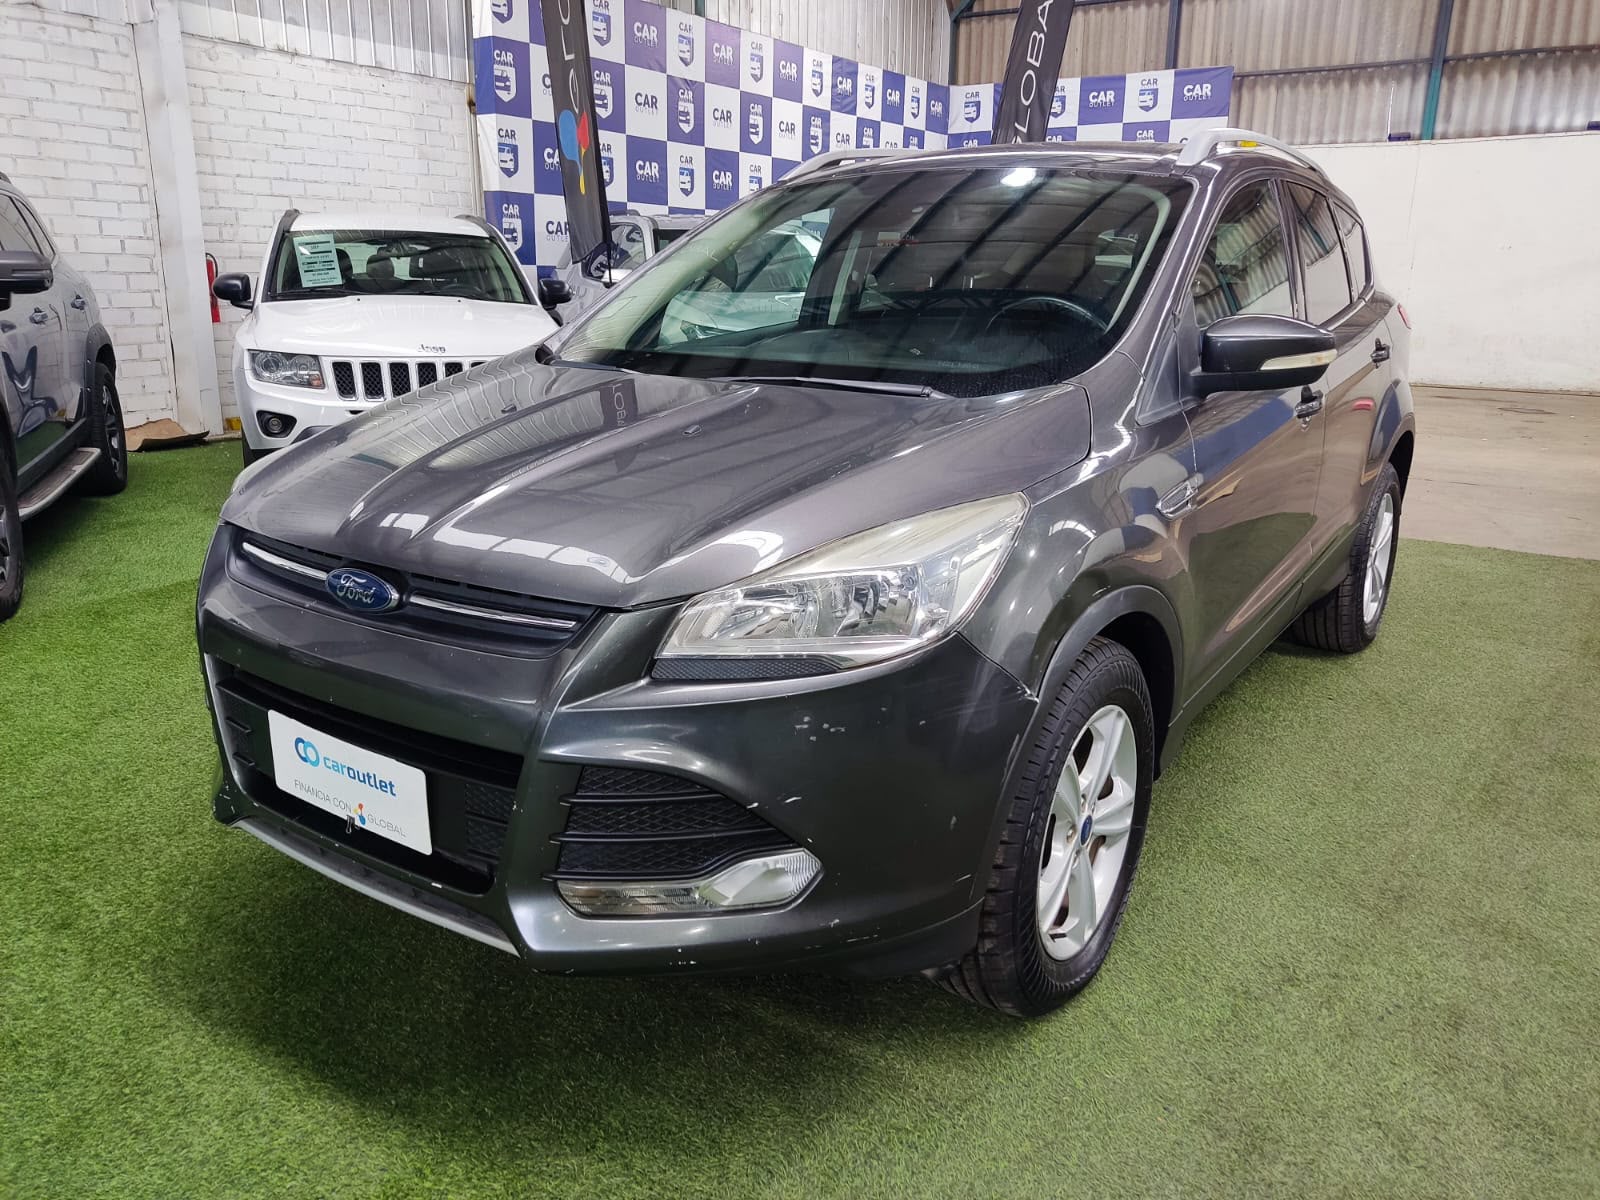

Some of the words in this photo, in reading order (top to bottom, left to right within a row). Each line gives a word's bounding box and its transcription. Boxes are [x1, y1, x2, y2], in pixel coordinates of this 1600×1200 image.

[633, 22, 658, 41] CAR
[713, 42, 733, 61] CAR
[750, 41, 763, 52] CAR
[493, 49, 514, 65] CAR
[812, 59, 823, 68] CAR
[779, 60, 797, 77] CAR
[593, 70, 611, 84] CAR
[837, 76, 853, 91] CAR
[1140, 78, 1158, 86] CAR
[678, 88, 693, 99] CAR
[886, 88, 900, 102] CAR
[1088, 90, 1115, 102] CAR
[1183, 83, 1212, 96] CAR
[634, 92, 658, 109] CAR
[930, 100, 943, 114] CAR
[712, 108, 732, 123] CAR
[749, 103, 762, 114] CAR
[778, 120, 796, 134] CAR
[810, 116, 822, 126] CAR
[497, 128, 516, 140] CAR
[835, 132, 851, 145] CAR
[863, 127, 873, 137] CAR
[1136, 129, 1154, 139] CAR
[679, 155, 693, 165] CAR
[635, 160, 659, 178] CAR
[749, 164, 762, 173] CAR
[712, 170, 732, 186] CAR
[502, 203, 519, 216] CAR
[336, 573, 376, 604] Ford
[323, 754, 397, 797] caroutlet
[294, 779, 330, 803] FINANCIA
[332, 796, 352, 813] CON
[367, 813, 407, 838] GLOBAL
